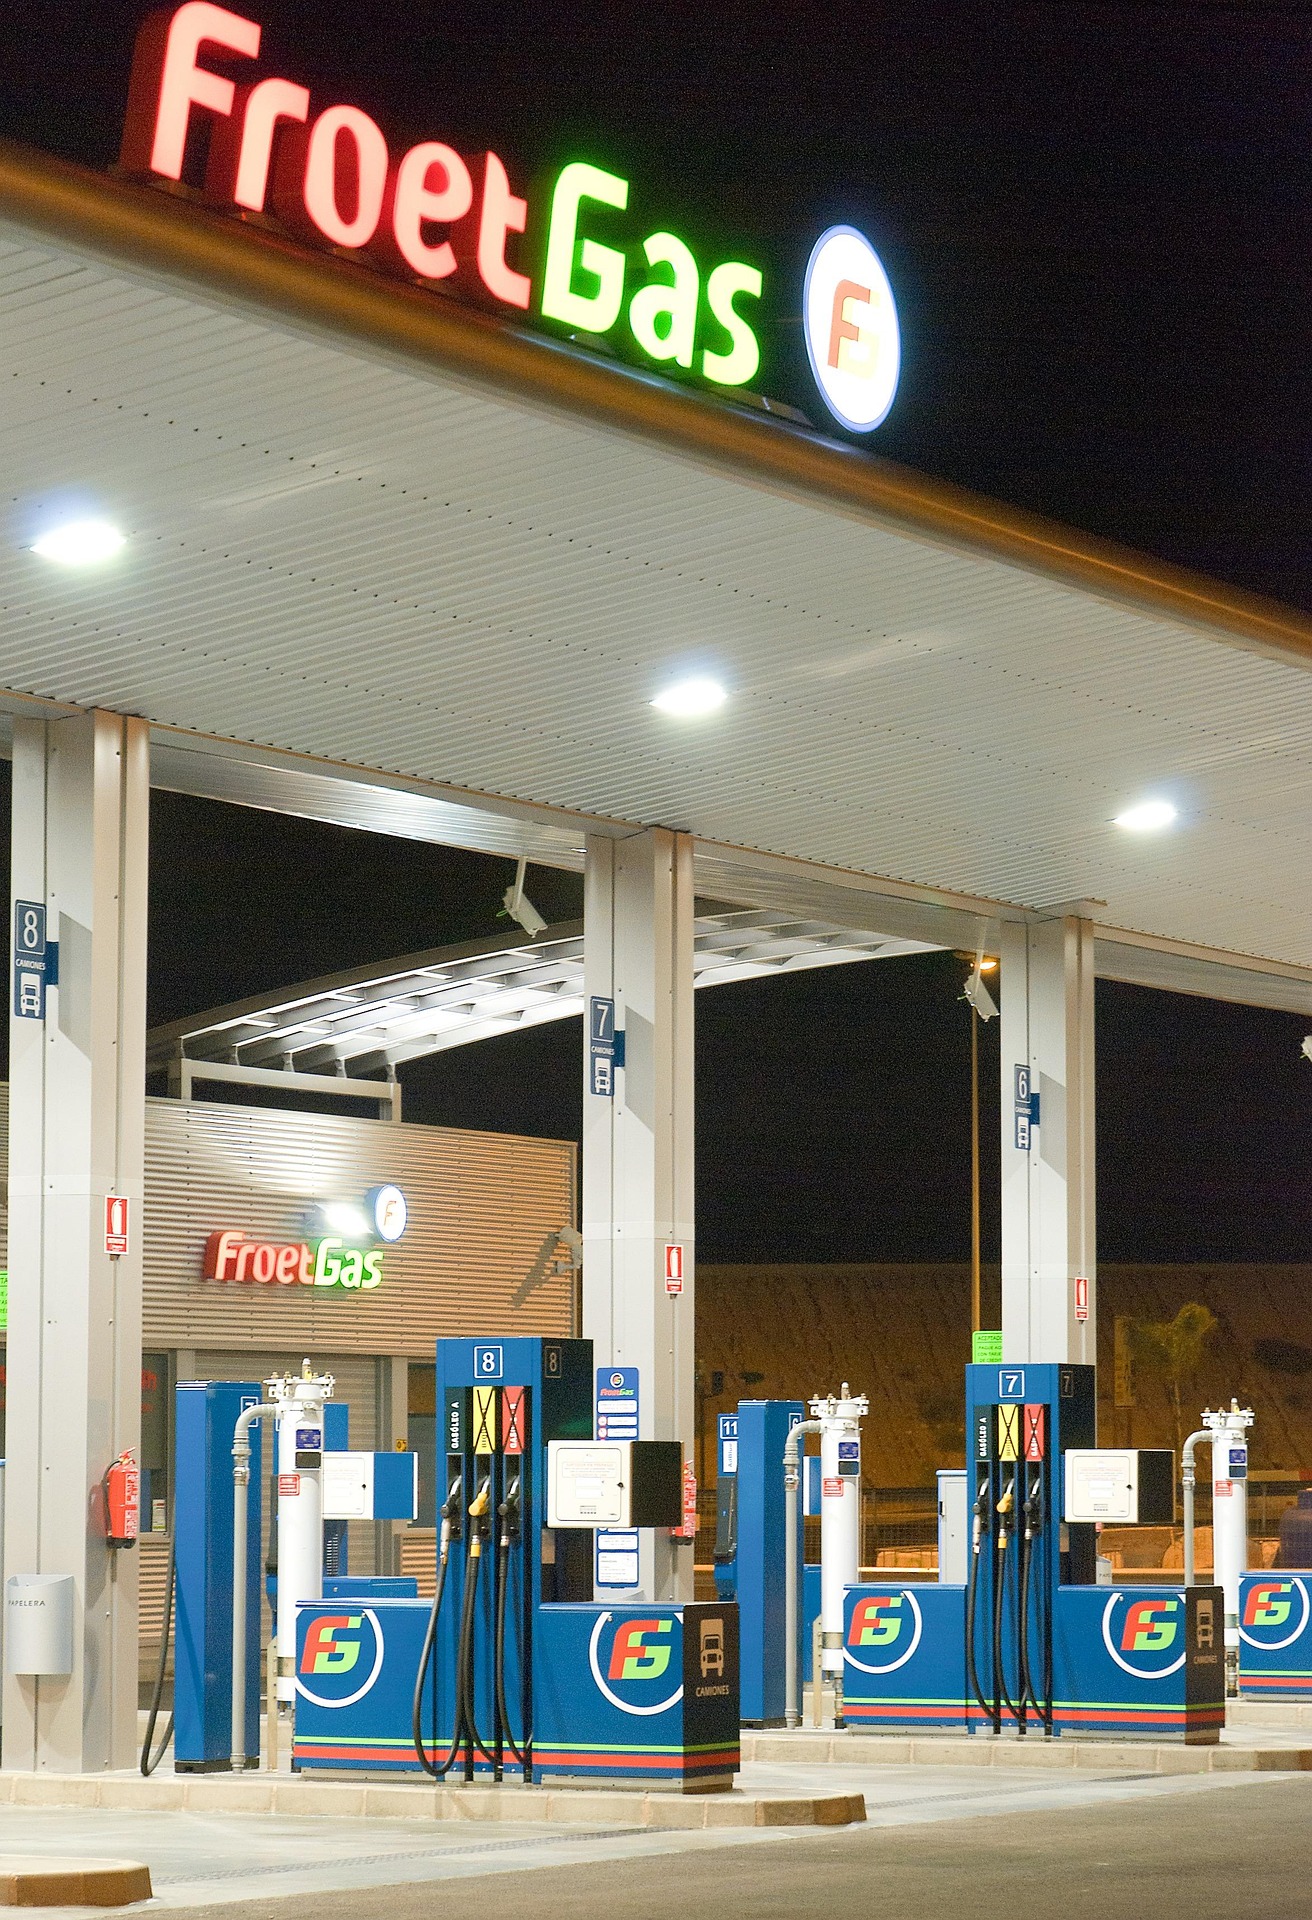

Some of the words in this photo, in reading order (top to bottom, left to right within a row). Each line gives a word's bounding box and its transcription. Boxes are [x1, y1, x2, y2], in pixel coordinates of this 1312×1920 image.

[150, 1, 762, 386] FroetGas
[23, 910, 38, 948] 8
[15, 958, 46, 971] CAMIONES
[597, 1004, 609, 1036] 7
[1019, 1071, 1027, 1099] 6
[214, 1231, 384, 1289] FroetGas
[482, 1351, 495, 1373] 8
[549, 1352, 557, 1372] 8
[1005, 1375, 1019, 1393] 7
[1063, 1375, 1070, 1393] 7
[450, 1401, 460, 1409] A
[450, 1411, 460, 1449] GASÓLEO
[723, 1420, 738, 1436] 11
